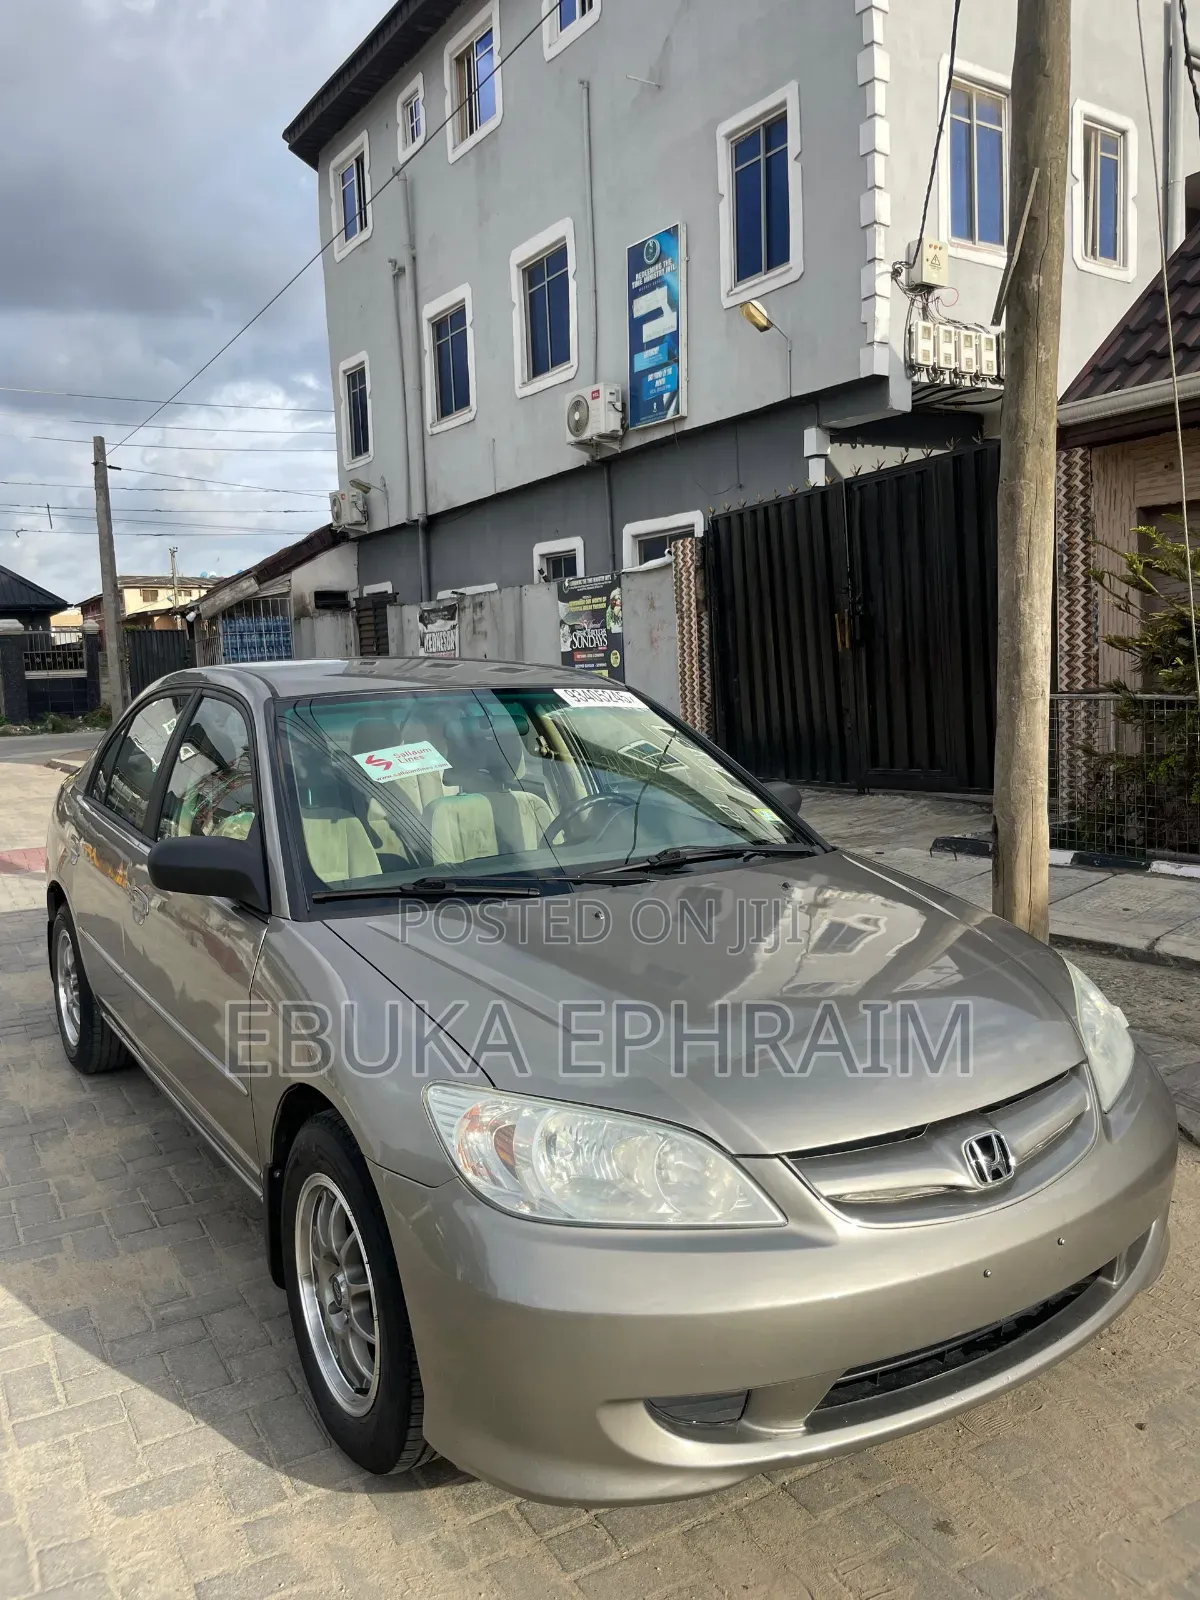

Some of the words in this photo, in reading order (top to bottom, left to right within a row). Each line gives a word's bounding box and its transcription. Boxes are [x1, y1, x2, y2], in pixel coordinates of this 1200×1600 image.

[572, 631, 608, 649] SUNDAYS
[393, 747, 432, 759] Sallaum
[398, 755, 425, 764] Lines
